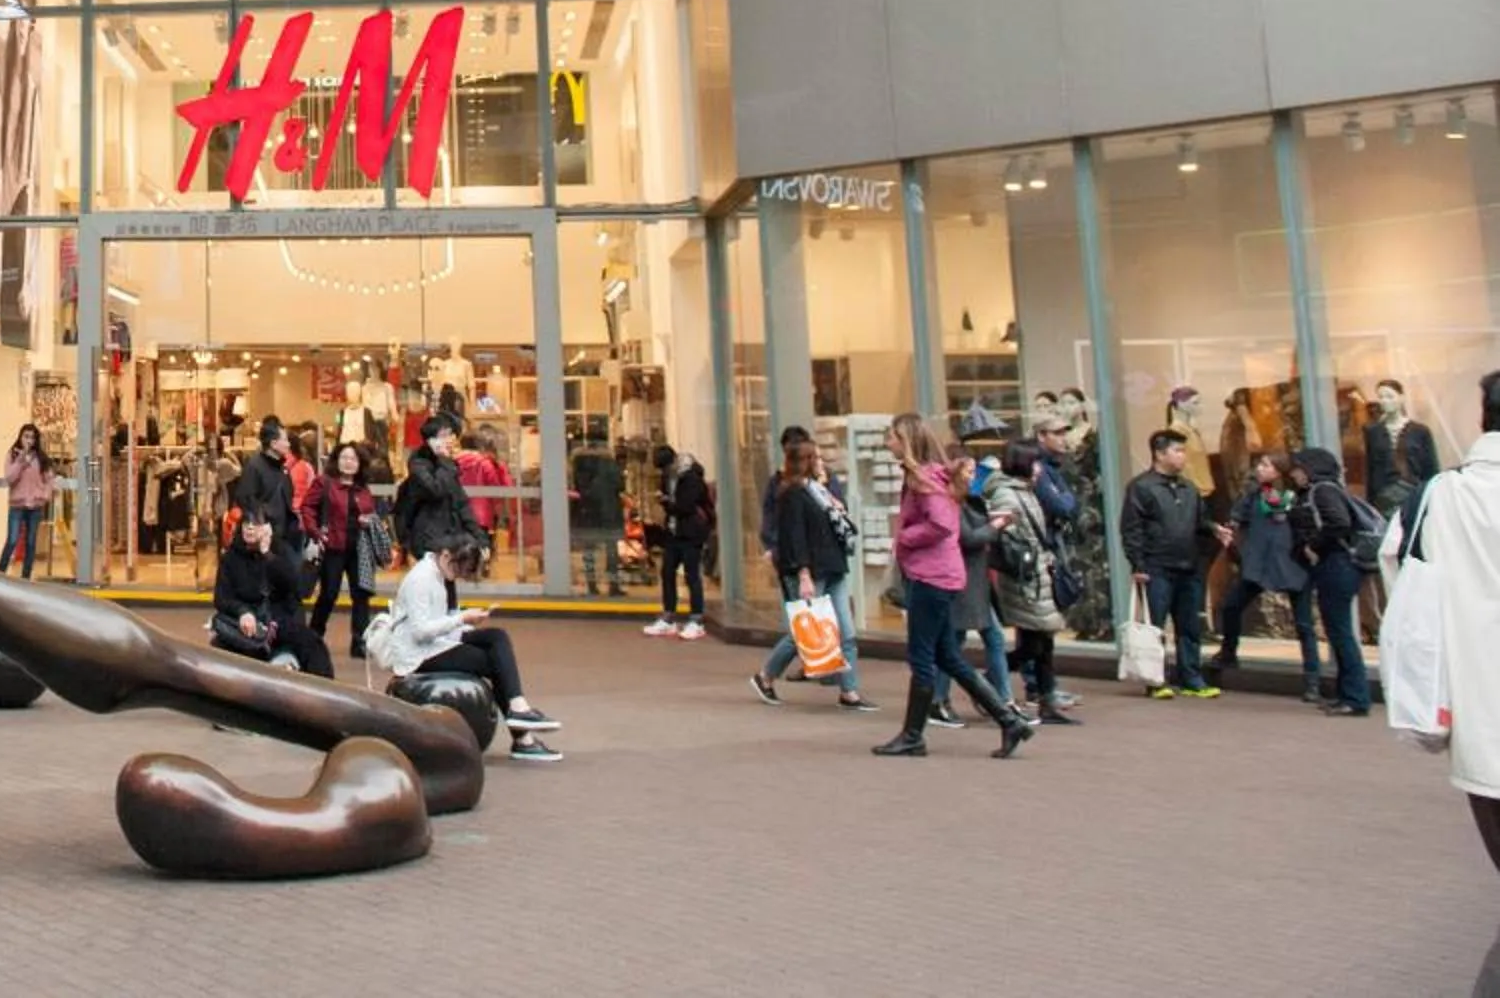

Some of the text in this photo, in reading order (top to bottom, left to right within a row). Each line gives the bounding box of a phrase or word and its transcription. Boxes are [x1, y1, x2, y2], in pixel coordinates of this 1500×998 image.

[176, 6, 464, 201] H&M
[275, 215, 373, 235] LANGHAM
[378, 213, 441, 233] PLACE
